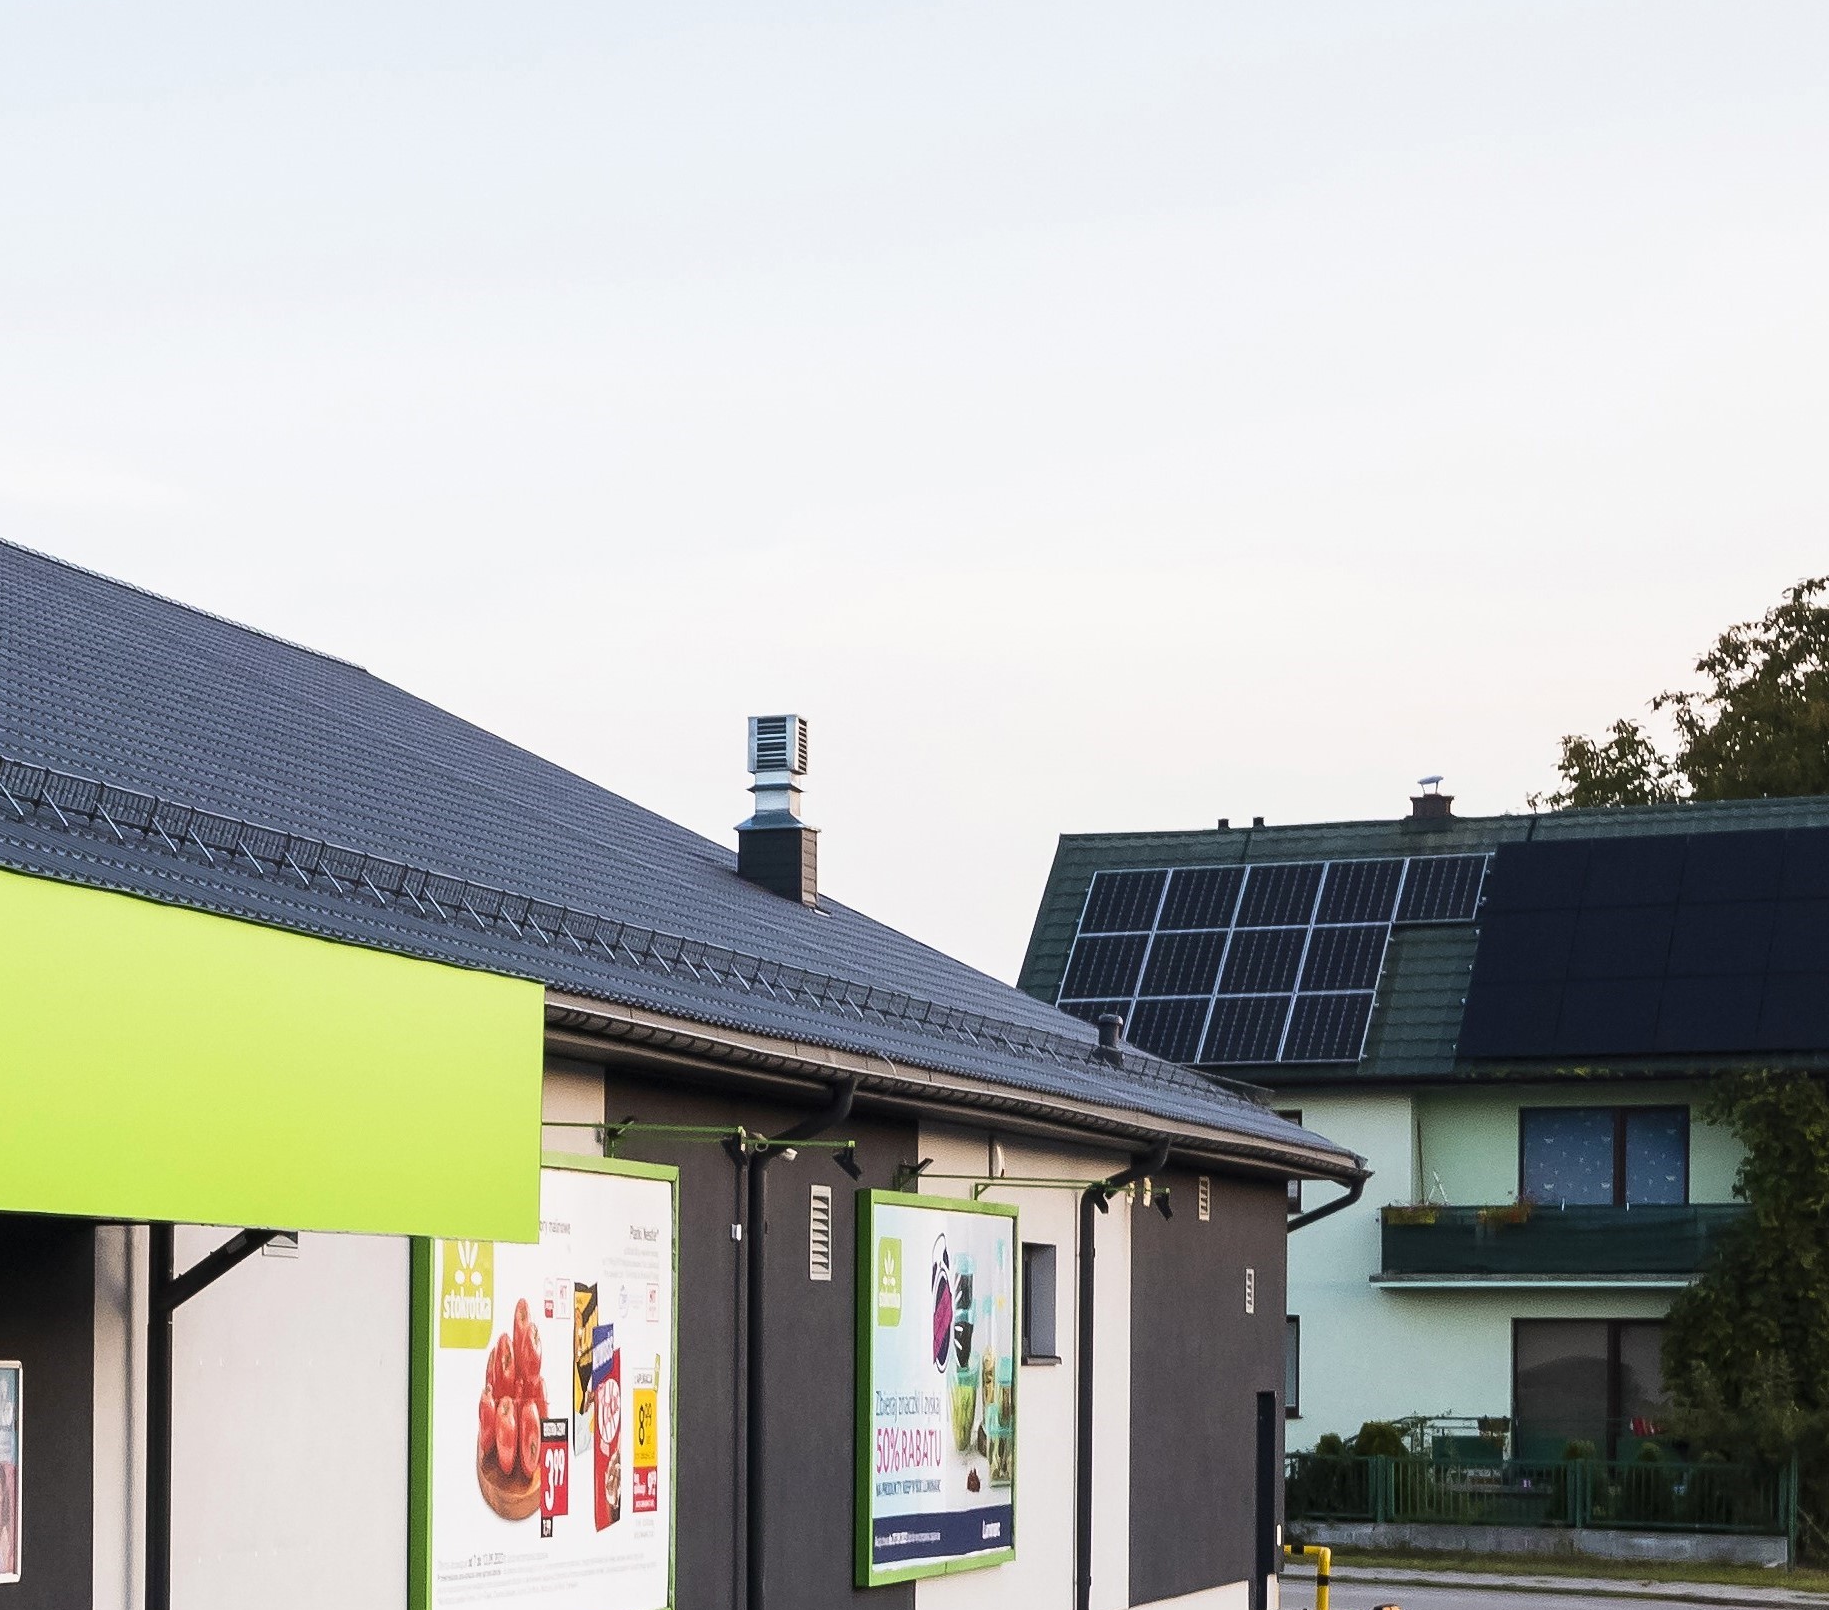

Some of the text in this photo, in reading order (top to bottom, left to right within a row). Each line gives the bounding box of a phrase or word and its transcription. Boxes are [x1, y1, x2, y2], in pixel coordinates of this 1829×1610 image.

[443, 1285, 492, 1320] stokrotka
[876, 1426, 941, 1474] 50% RABATU
